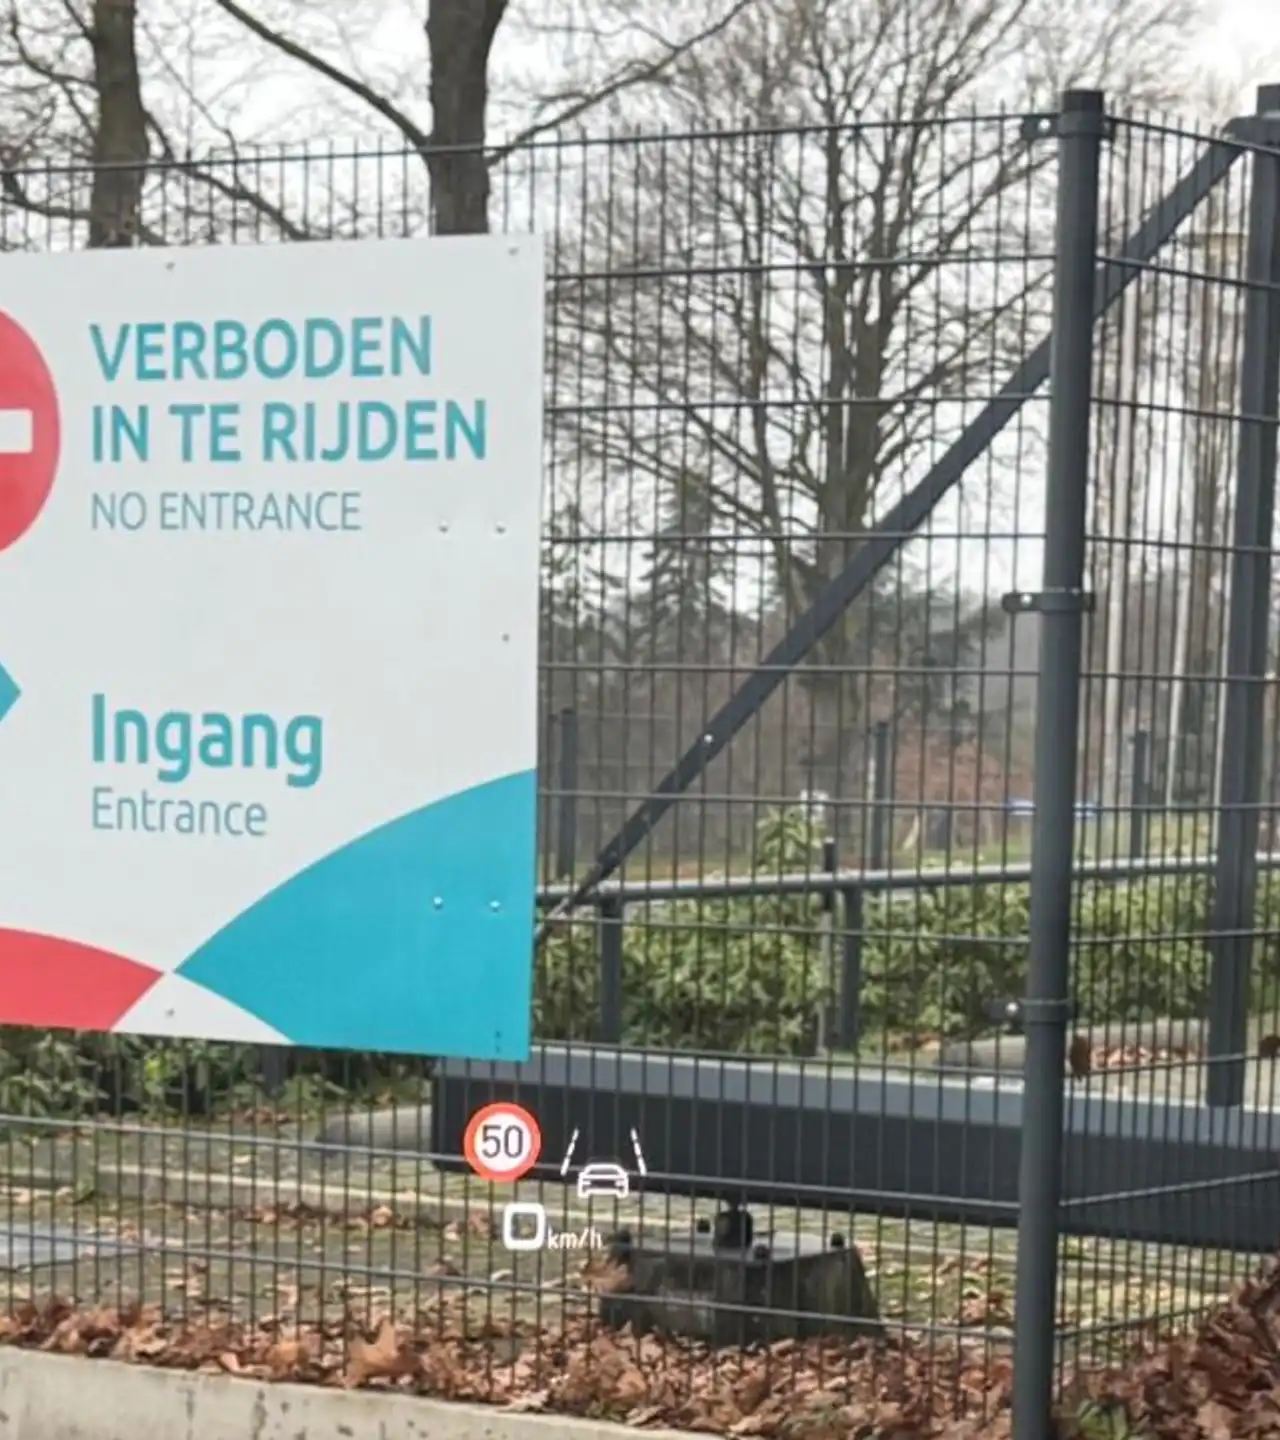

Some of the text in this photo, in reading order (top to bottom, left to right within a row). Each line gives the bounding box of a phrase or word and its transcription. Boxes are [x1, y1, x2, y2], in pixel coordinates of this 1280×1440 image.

[89, 315, 432, 381] VERBODEN
[92, 399, 487, 462] IN TE RIJDEN
[90, 490, 361, 531] NO ENTRANCE
[91, 692, 324, 788] Ingang
[92, 786, 268, 837] Entrance
[481, 1124, 524, 1160] 50
[503, 1202, 603, 1251] 0 km/h
